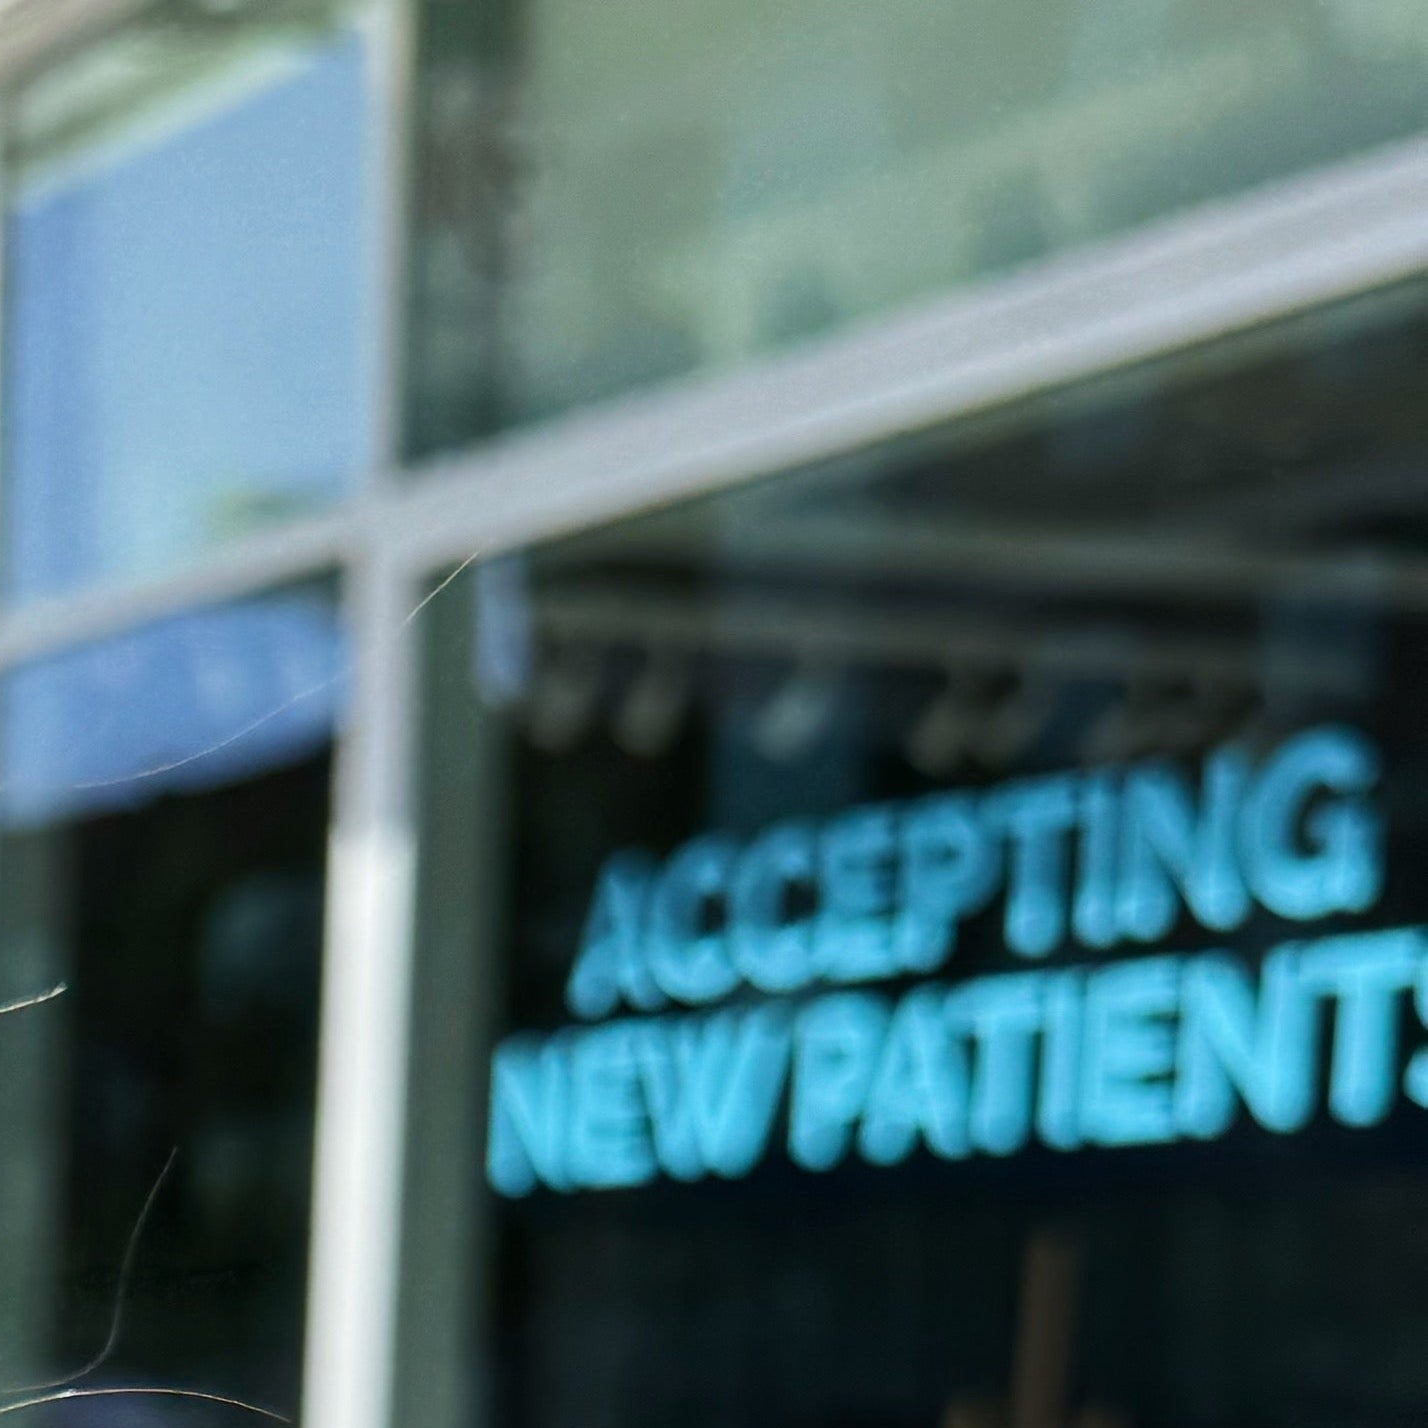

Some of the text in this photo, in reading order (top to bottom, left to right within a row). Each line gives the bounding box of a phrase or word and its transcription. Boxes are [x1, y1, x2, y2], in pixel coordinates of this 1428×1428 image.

[567, 727, 1385, 1017] ACCEPTING
[486, 927, 1428, 1196] NEW PATIENT
